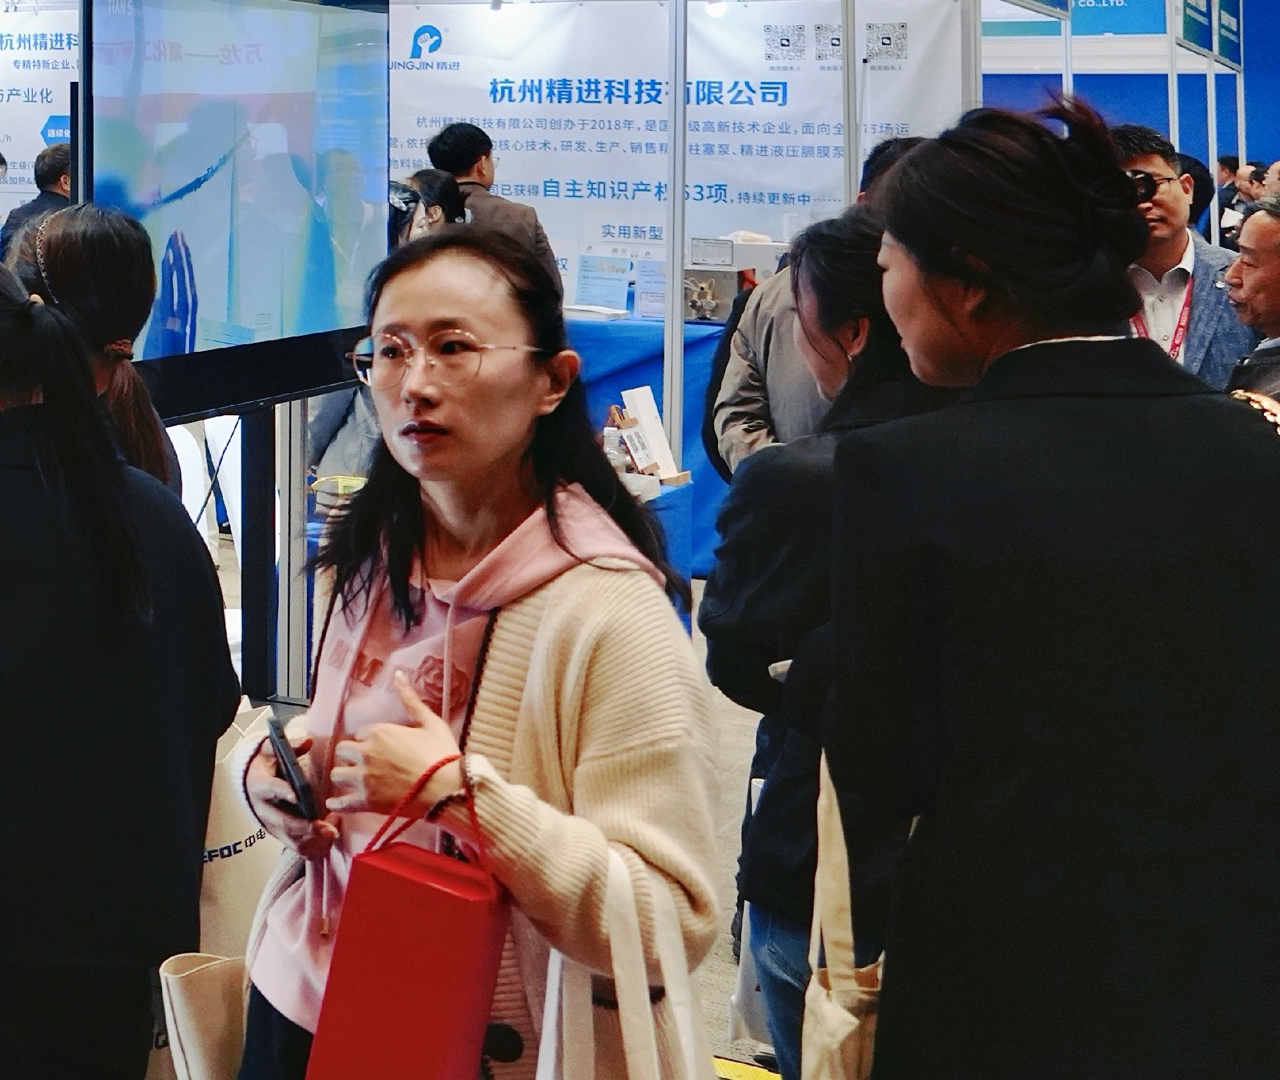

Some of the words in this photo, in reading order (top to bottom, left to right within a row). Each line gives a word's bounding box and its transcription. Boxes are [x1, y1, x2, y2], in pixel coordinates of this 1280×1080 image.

[435, 61, 461, 71] 精进
[601, 223, 664, 240] 实用新型
